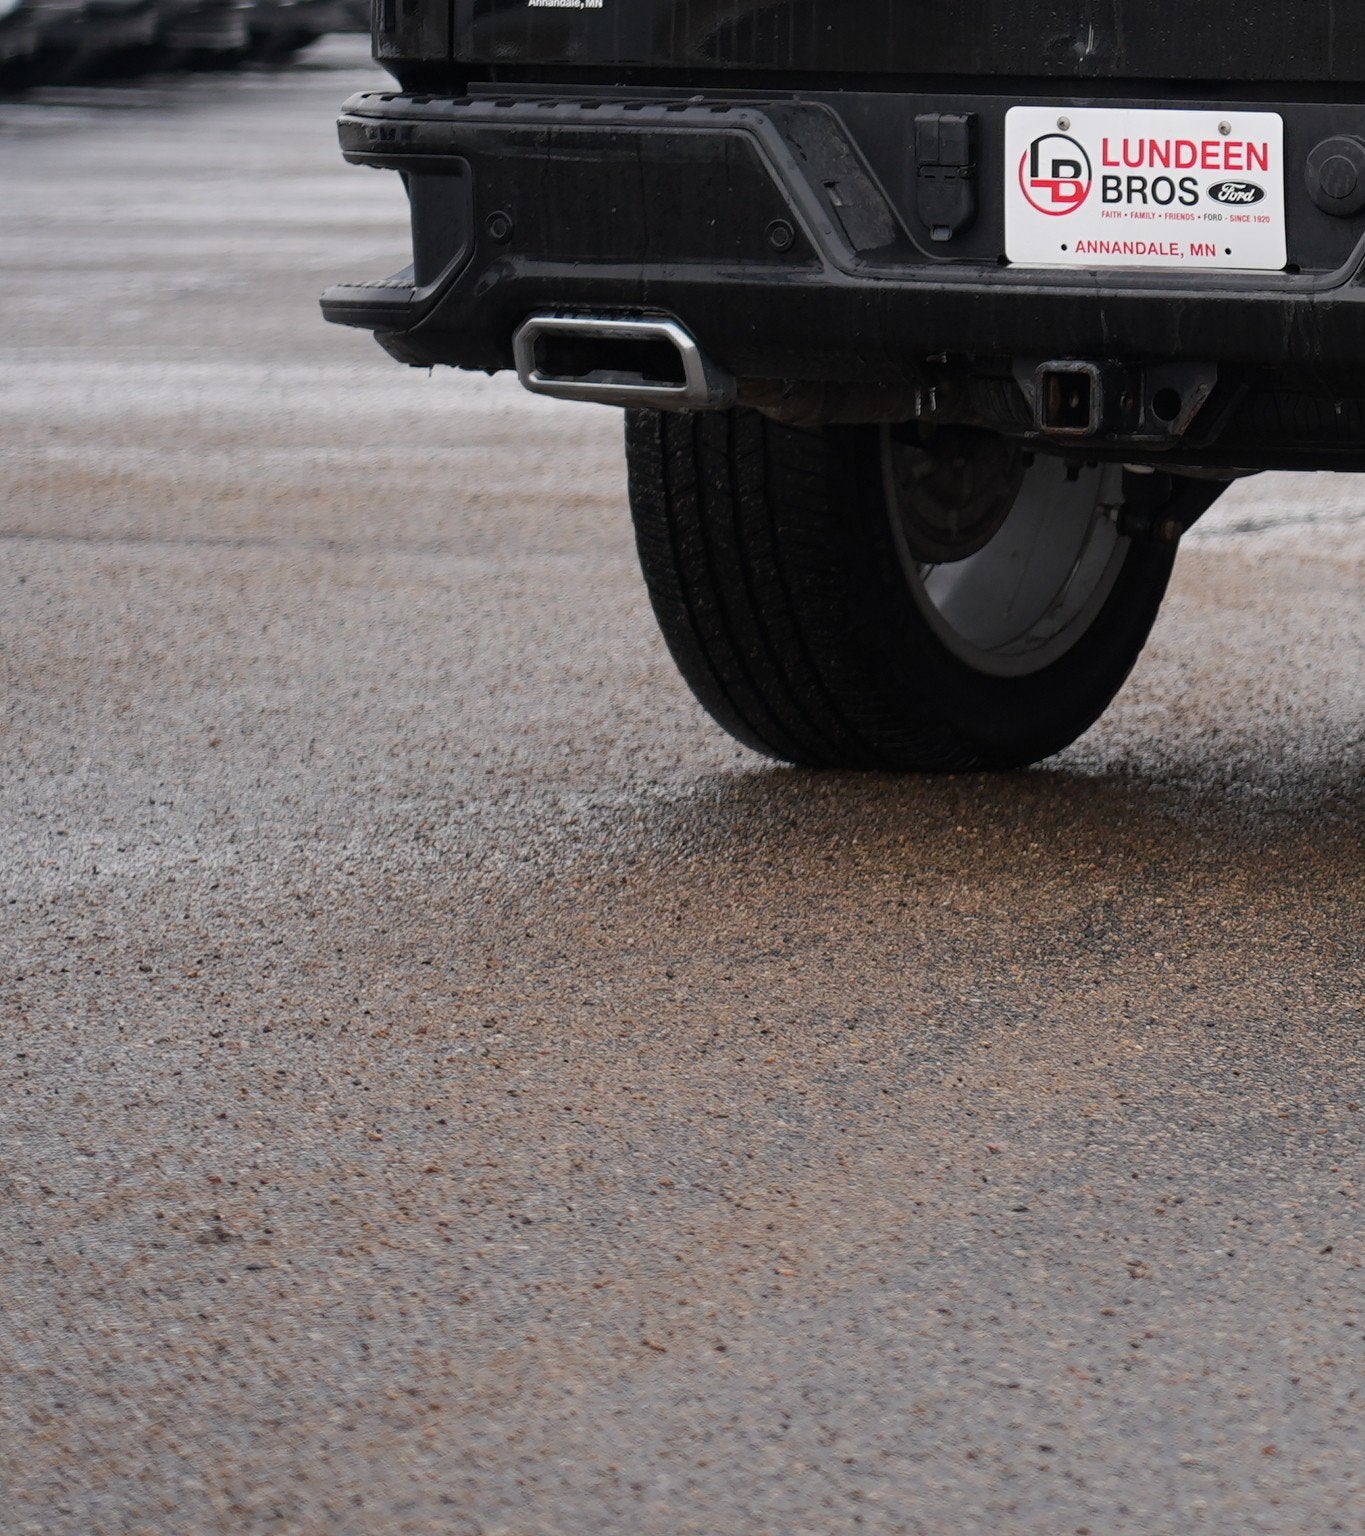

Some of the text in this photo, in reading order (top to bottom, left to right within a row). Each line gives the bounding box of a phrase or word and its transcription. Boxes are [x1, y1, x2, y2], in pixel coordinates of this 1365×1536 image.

[1102, 137, 1269, 172] LUNDEEN
[1101, 174, 1200, 207] BROS
[1215, 182, 1256, 203] Ford
[1101, 210, 1271, 223] FAITH FAMILY FRIENDS FORD SINCE 1920
[1074, 239, 1217, 259] ANNANDALE, MN
